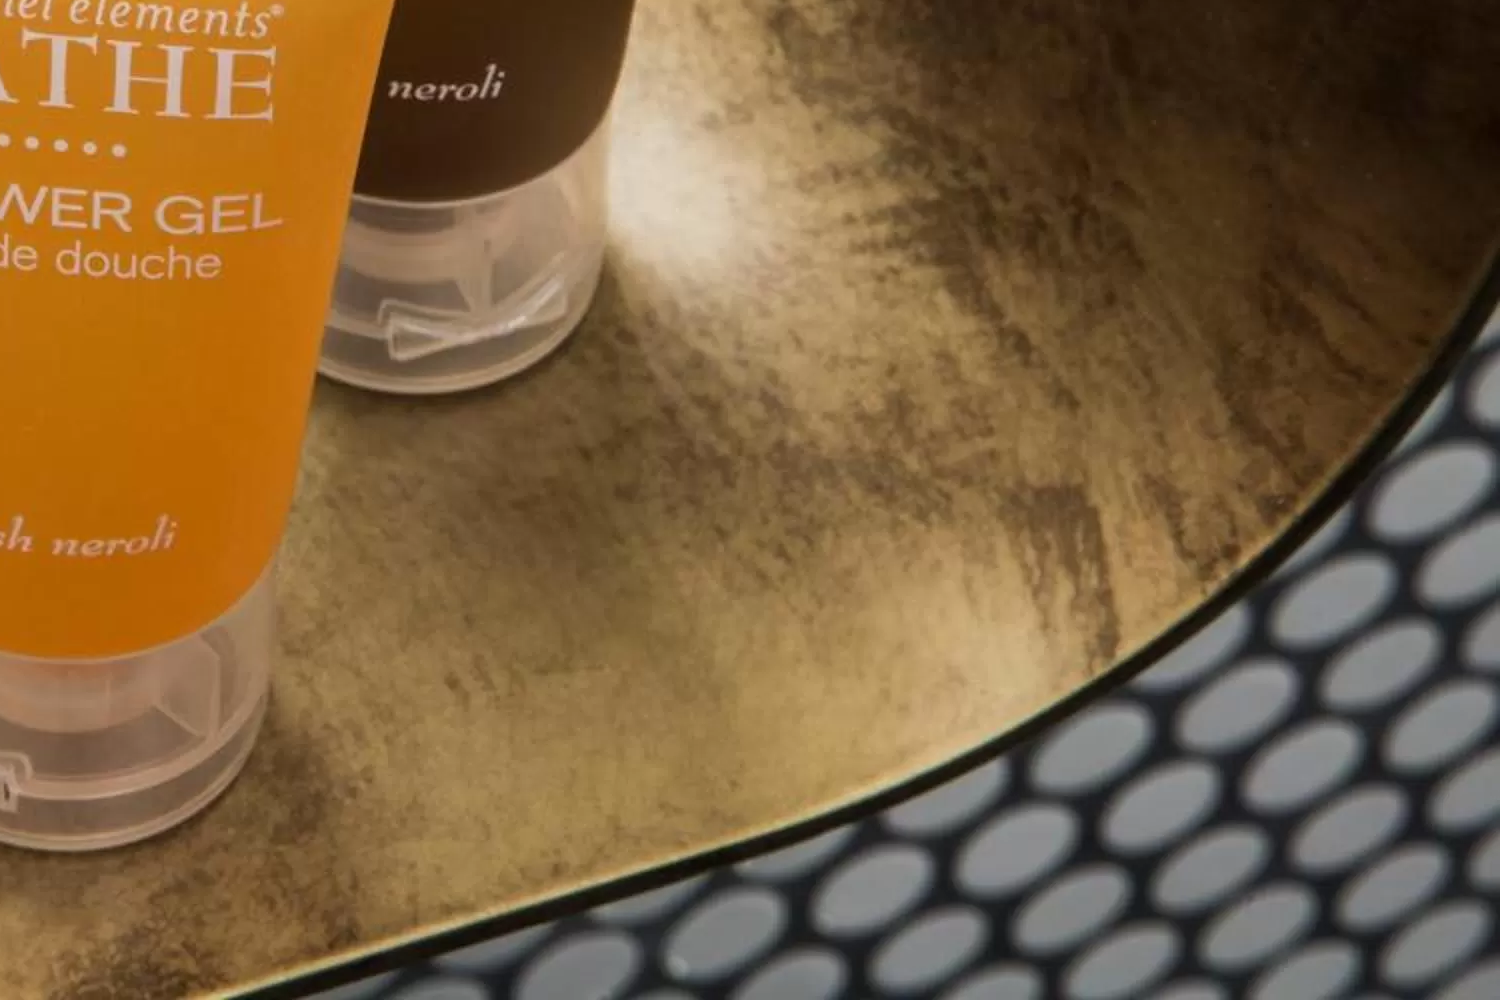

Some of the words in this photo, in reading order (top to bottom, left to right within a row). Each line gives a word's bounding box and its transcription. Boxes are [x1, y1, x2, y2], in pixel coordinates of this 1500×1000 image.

[387, 62, 506, 102] neroli
[155, 193, 283, 235] GEL
[55, 240, 222, 280] douche
[51, 512, 178, 558] neroli
